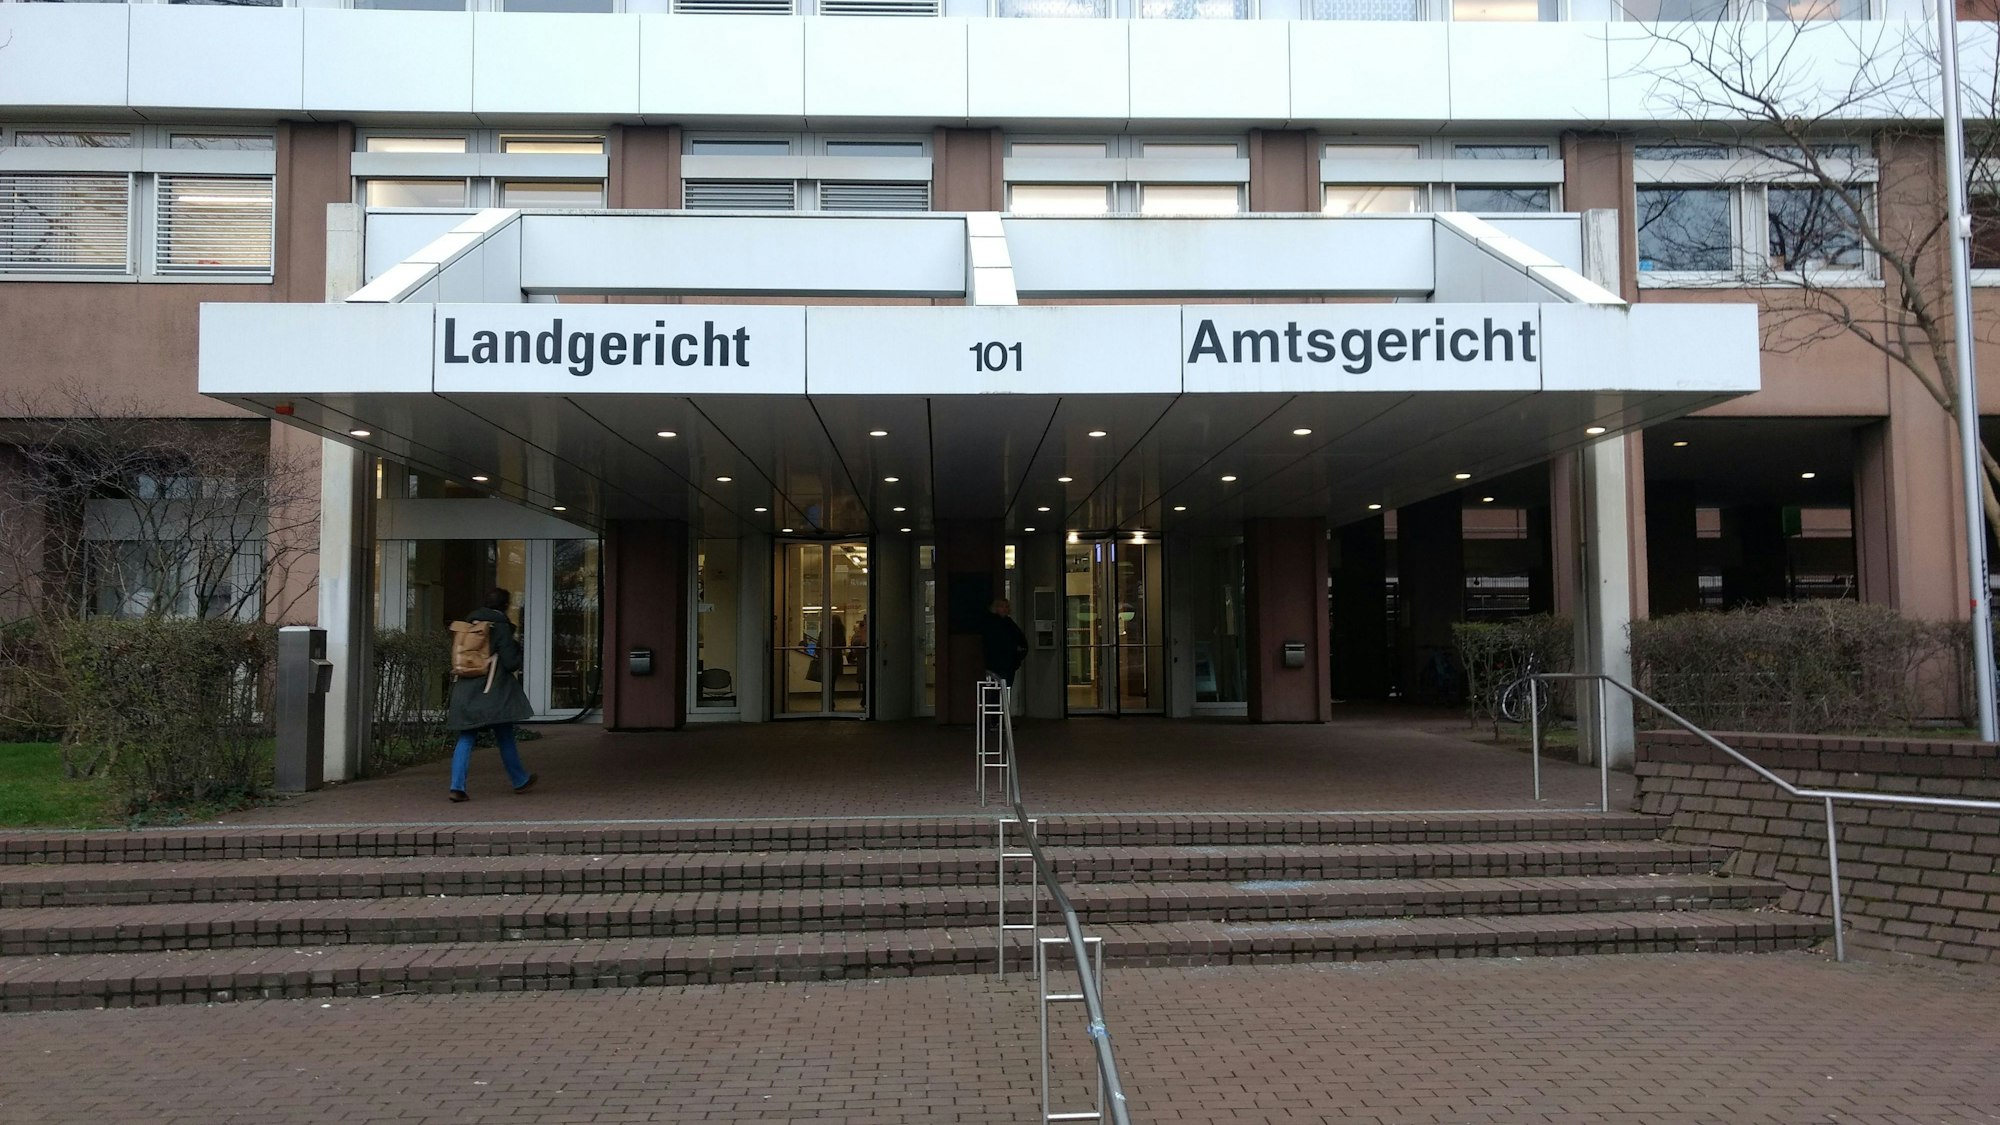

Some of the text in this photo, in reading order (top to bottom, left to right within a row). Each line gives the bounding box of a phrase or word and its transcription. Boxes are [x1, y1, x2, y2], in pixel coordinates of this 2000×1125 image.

[445, 318, 750, 376] Landgericht
[969, 342, 1023, 372] 101
[1188, 318, 1537, 375] Amtsgericht
